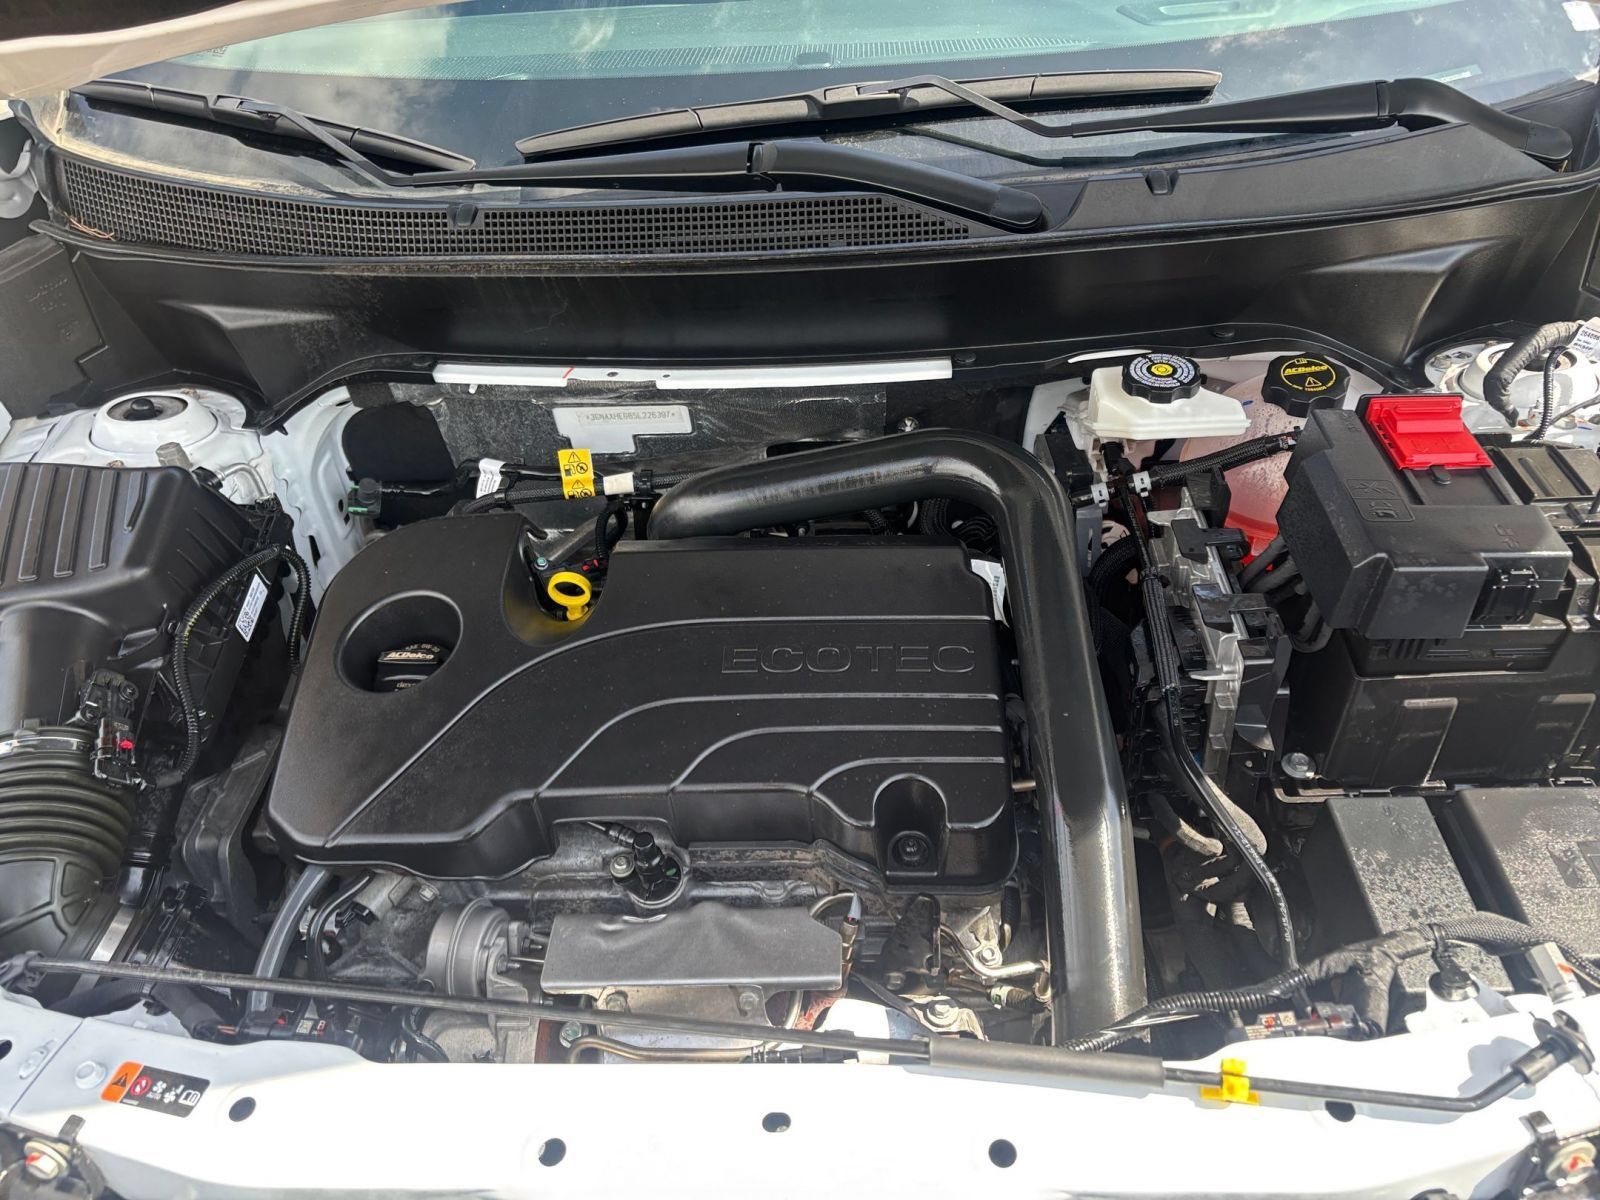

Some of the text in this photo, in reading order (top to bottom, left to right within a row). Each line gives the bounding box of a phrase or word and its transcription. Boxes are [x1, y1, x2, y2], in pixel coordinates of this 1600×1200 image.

[1285, 365, 1328, 375] ACDelco
[386, 651, 435, 660] ACDelco
[721, 645, 975, 674] ECOTEC
